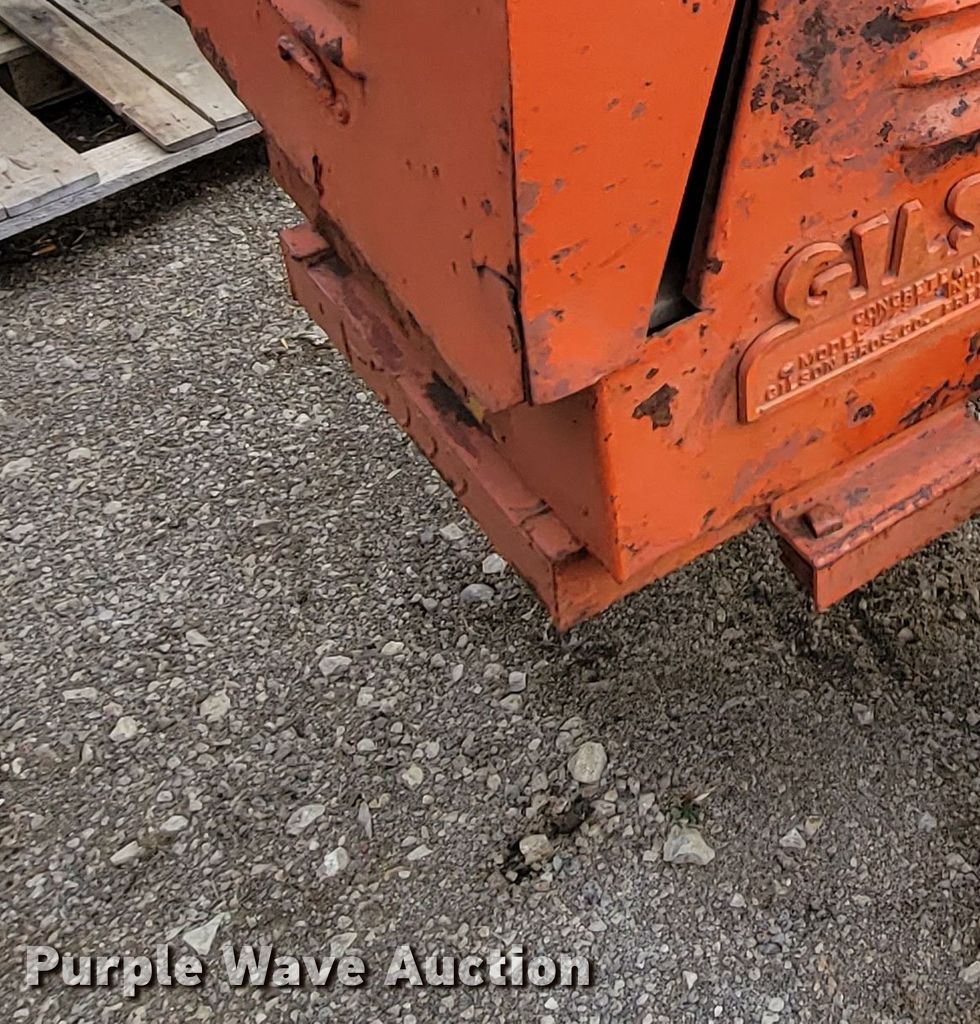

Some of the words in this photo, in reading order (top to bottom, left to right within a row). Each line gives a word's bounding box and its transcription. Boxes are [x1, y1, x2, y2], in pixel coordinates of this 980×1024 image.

[851, 267, 949, 326] CONCRETE
[797, 329, 864, 370] MODEL
[764, 356, 838, 403] GILSON
